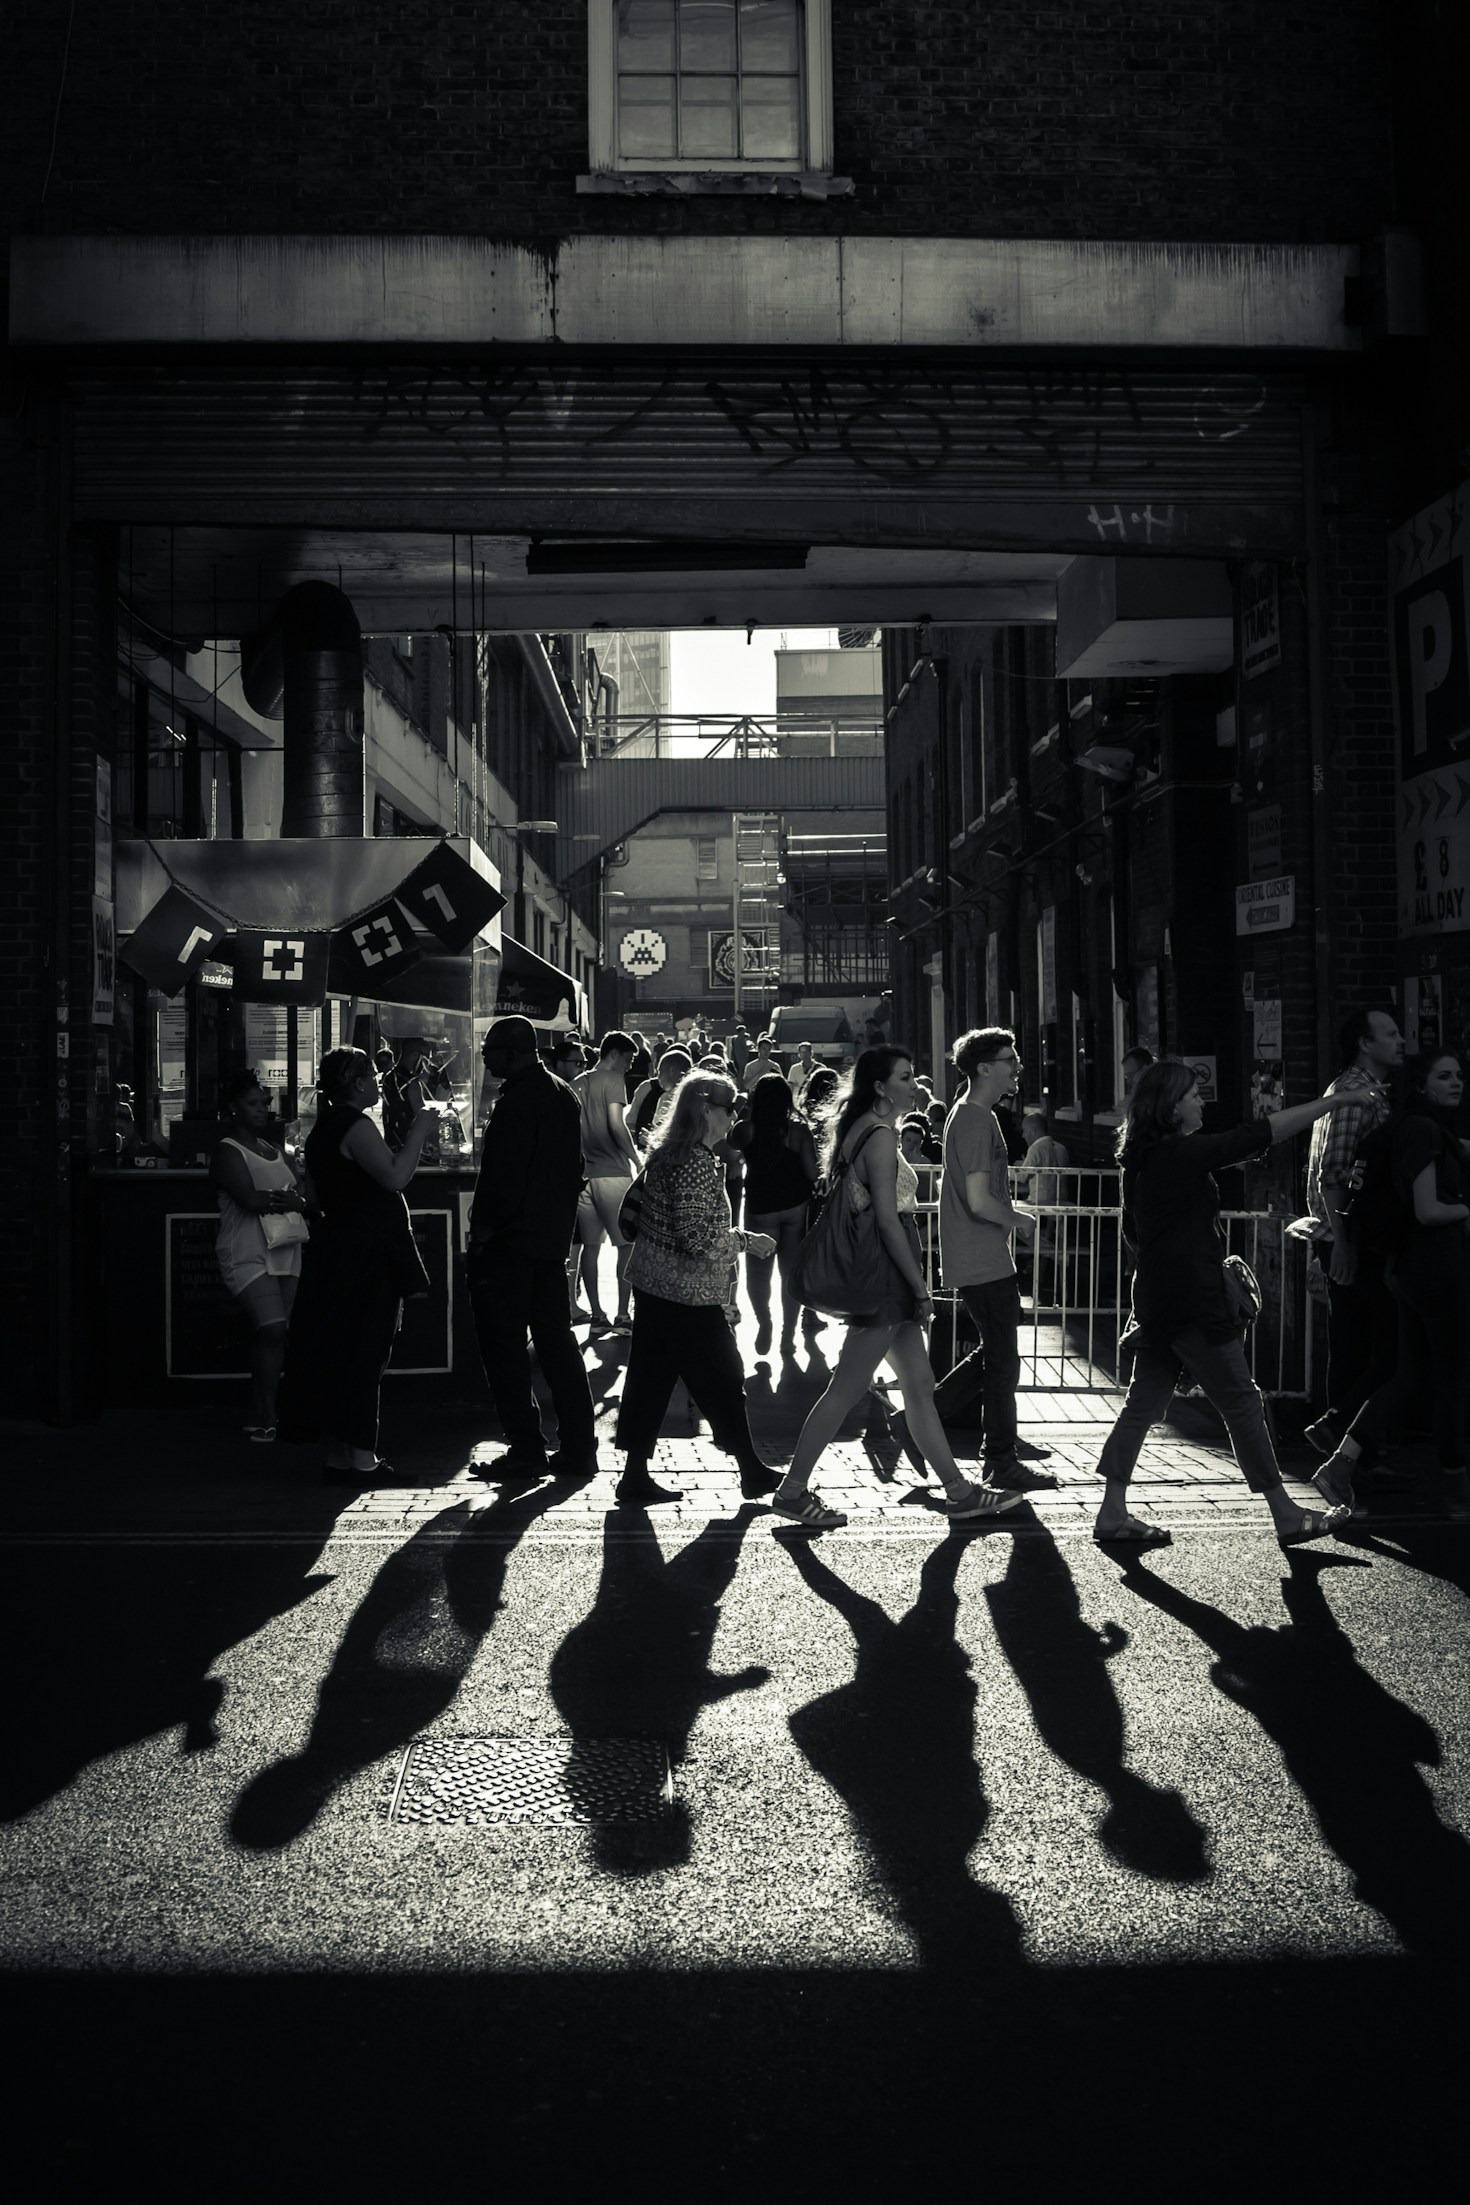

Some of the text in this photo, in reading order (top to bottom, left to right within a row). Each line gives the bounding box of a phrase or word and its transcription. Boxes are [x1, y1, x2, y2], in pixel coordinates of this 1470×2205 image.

[1407, 588, 1453, 757] P
[1237, 878, 1291, 904] ORIENTAL CUISINE
[1415, 887, 1465, 926] ALL DAY
